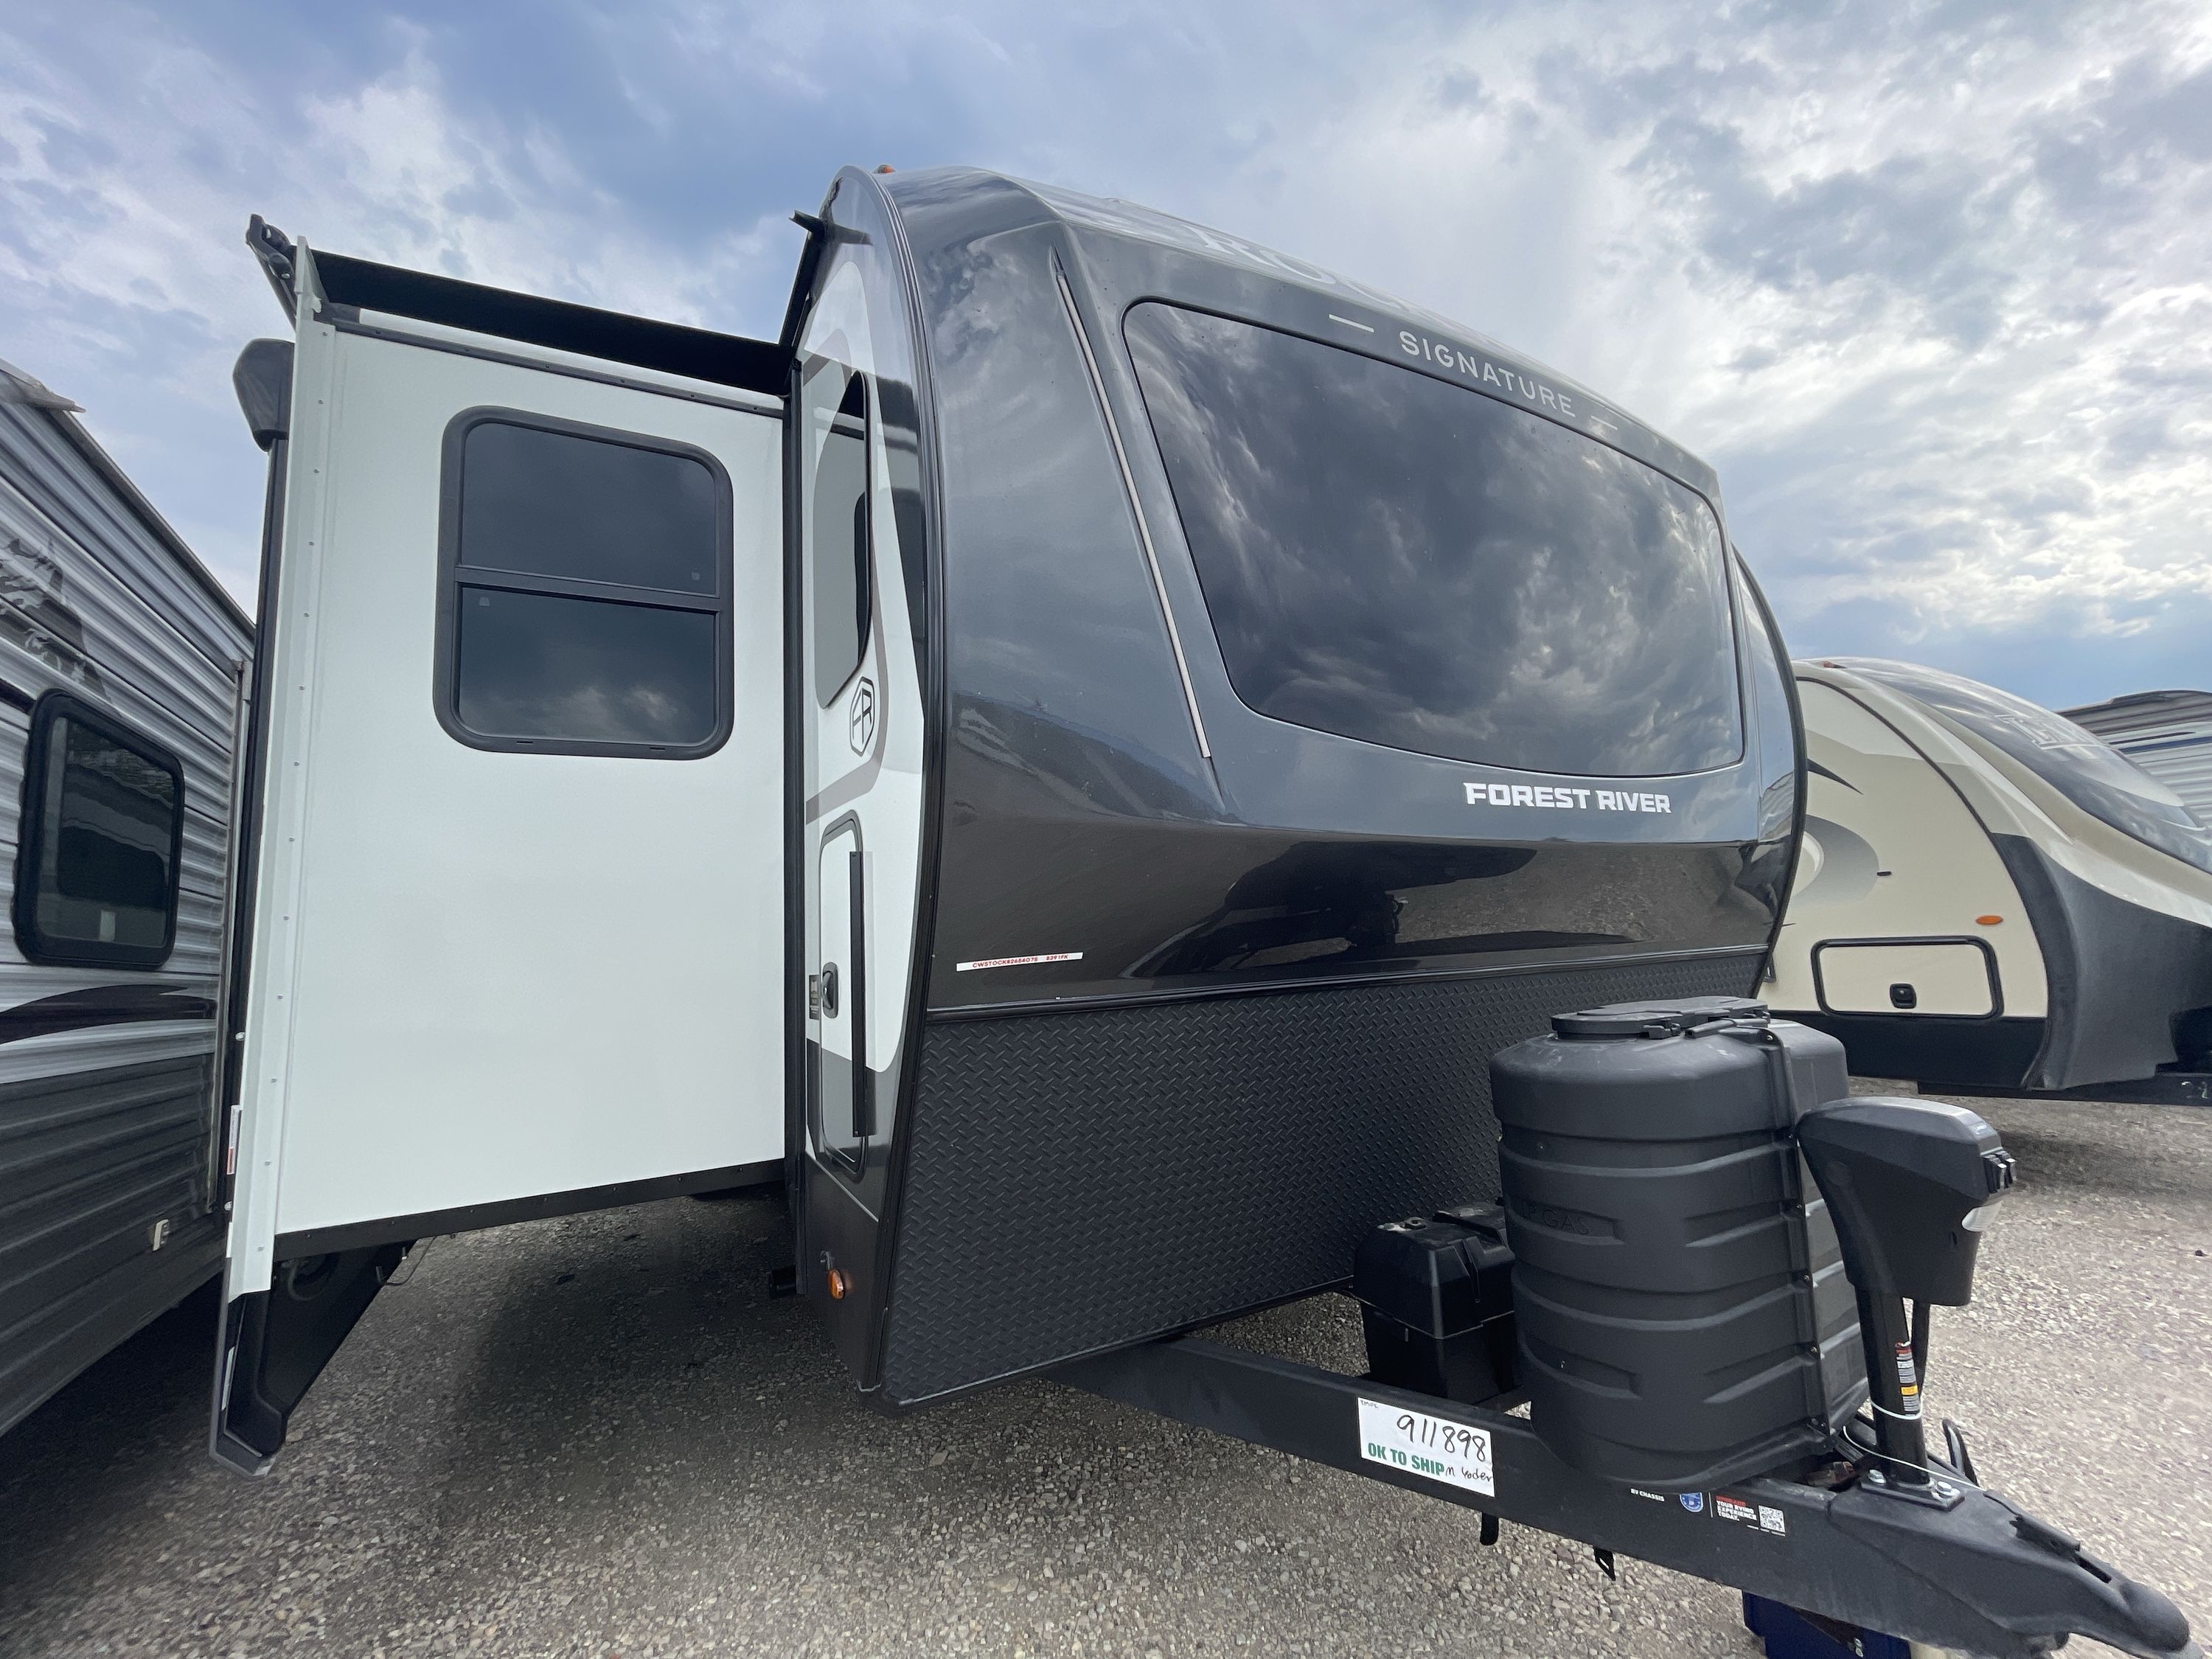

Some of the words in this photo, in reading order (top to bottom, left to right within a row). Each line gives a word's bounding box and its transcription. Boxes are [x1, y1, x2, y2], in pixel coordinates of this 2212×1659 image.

[1399, 330, 1576, 418] SIGNATURE
[1463, 782, 1591, 809] FOREST
[1595, 790, 1672, 813] RIVER
[1543, 1208, 1590, 1235] GAS
[1397, 1414, 1486, 1462] 911898
[1368, 1442, 1388, 1461] OK
[1389, 1448, 1407, 1466] TO
[1411, 1455, 1444, 1476] SHIP
[1639, 1490, 1665, 1502] CHASSIS
[1717, 1500, 1733, 1509] YOUR
[1717, 1506, 1757, 1520] EXPERIENCE
